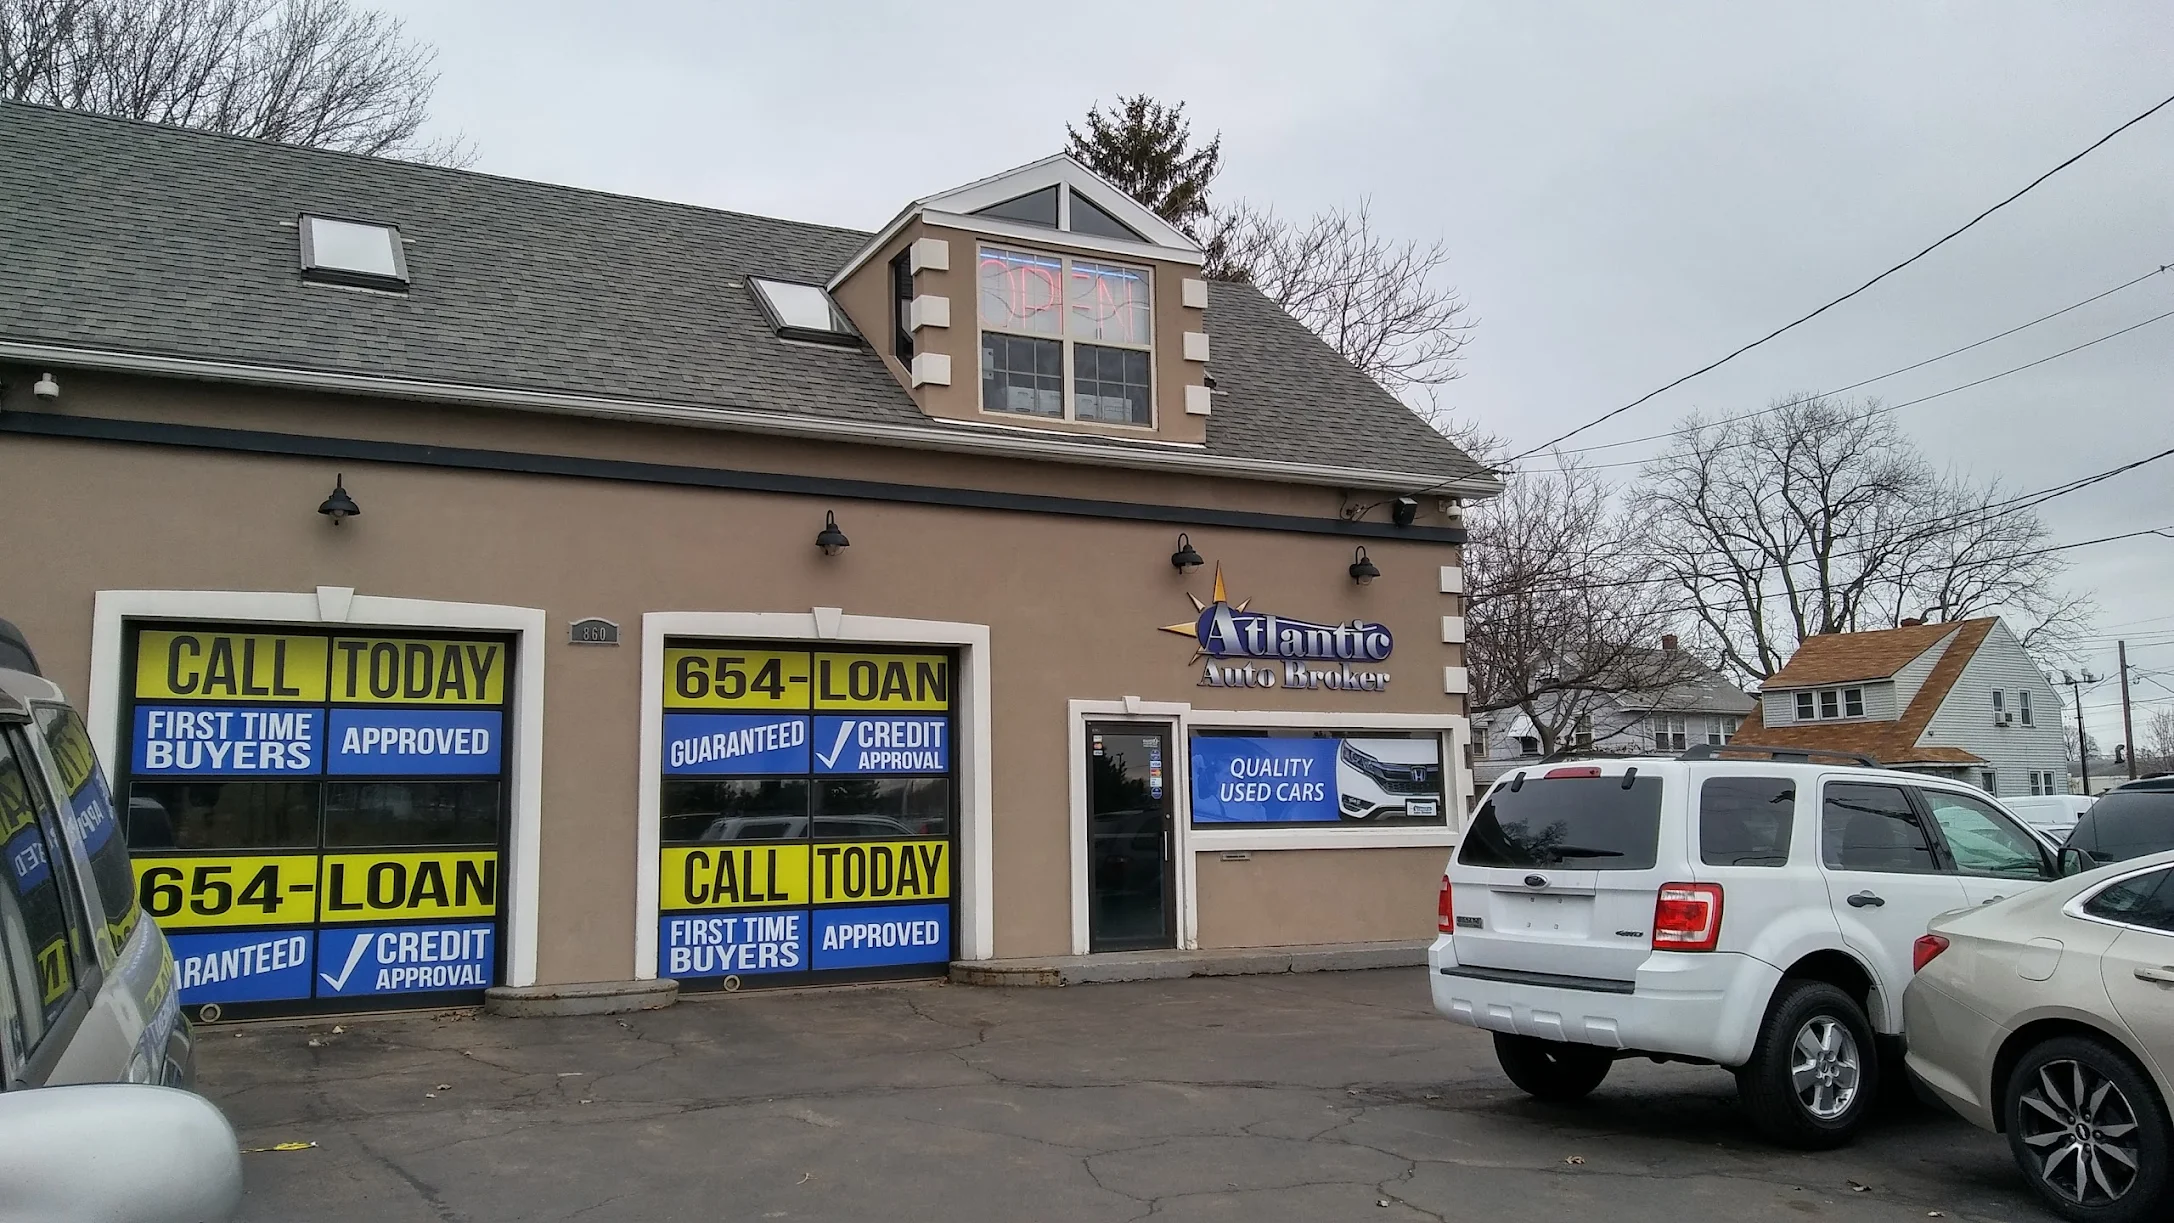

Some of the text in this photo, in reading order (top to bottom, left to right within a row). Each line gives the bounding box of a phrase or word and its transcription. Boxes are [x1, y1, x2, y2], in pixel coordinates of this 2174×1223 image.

[980, 259, 1132, 341] OPEN
[583, 627, 606, 641] 860
[1198, 601, 1391, 660] Atlantic
[168, 635, 497, 700] CALL TODAY
[1197, 658, 1391, 692] Auto Broker
[147, 711, 312, 740] FIRST TIME
[341, 727, 490, 755] APPROVED
[858, 721, 945, 748] CREDIT
[146, 740, 311, 769] BUYERS
[671, 720, 804, 768] GUARANTEED
[858, 751, 943, 770] APPROVAL
[1230, 758, 1314, 779] QUALITY
[1220, 782, 1325, 802] USED CARS
[684, 844, 943, 905] CALL TODAY
[671, 915, 799, 946] FIRST TIME
[822, 920, 939, 951] APPROVED
[376, 929, 491, 964] CREDIT
[670, 941, 799, 974] BUYERS
[173, 935, 306, 991] RANTEED
[375, 964, 487, 990] APPROVAL
